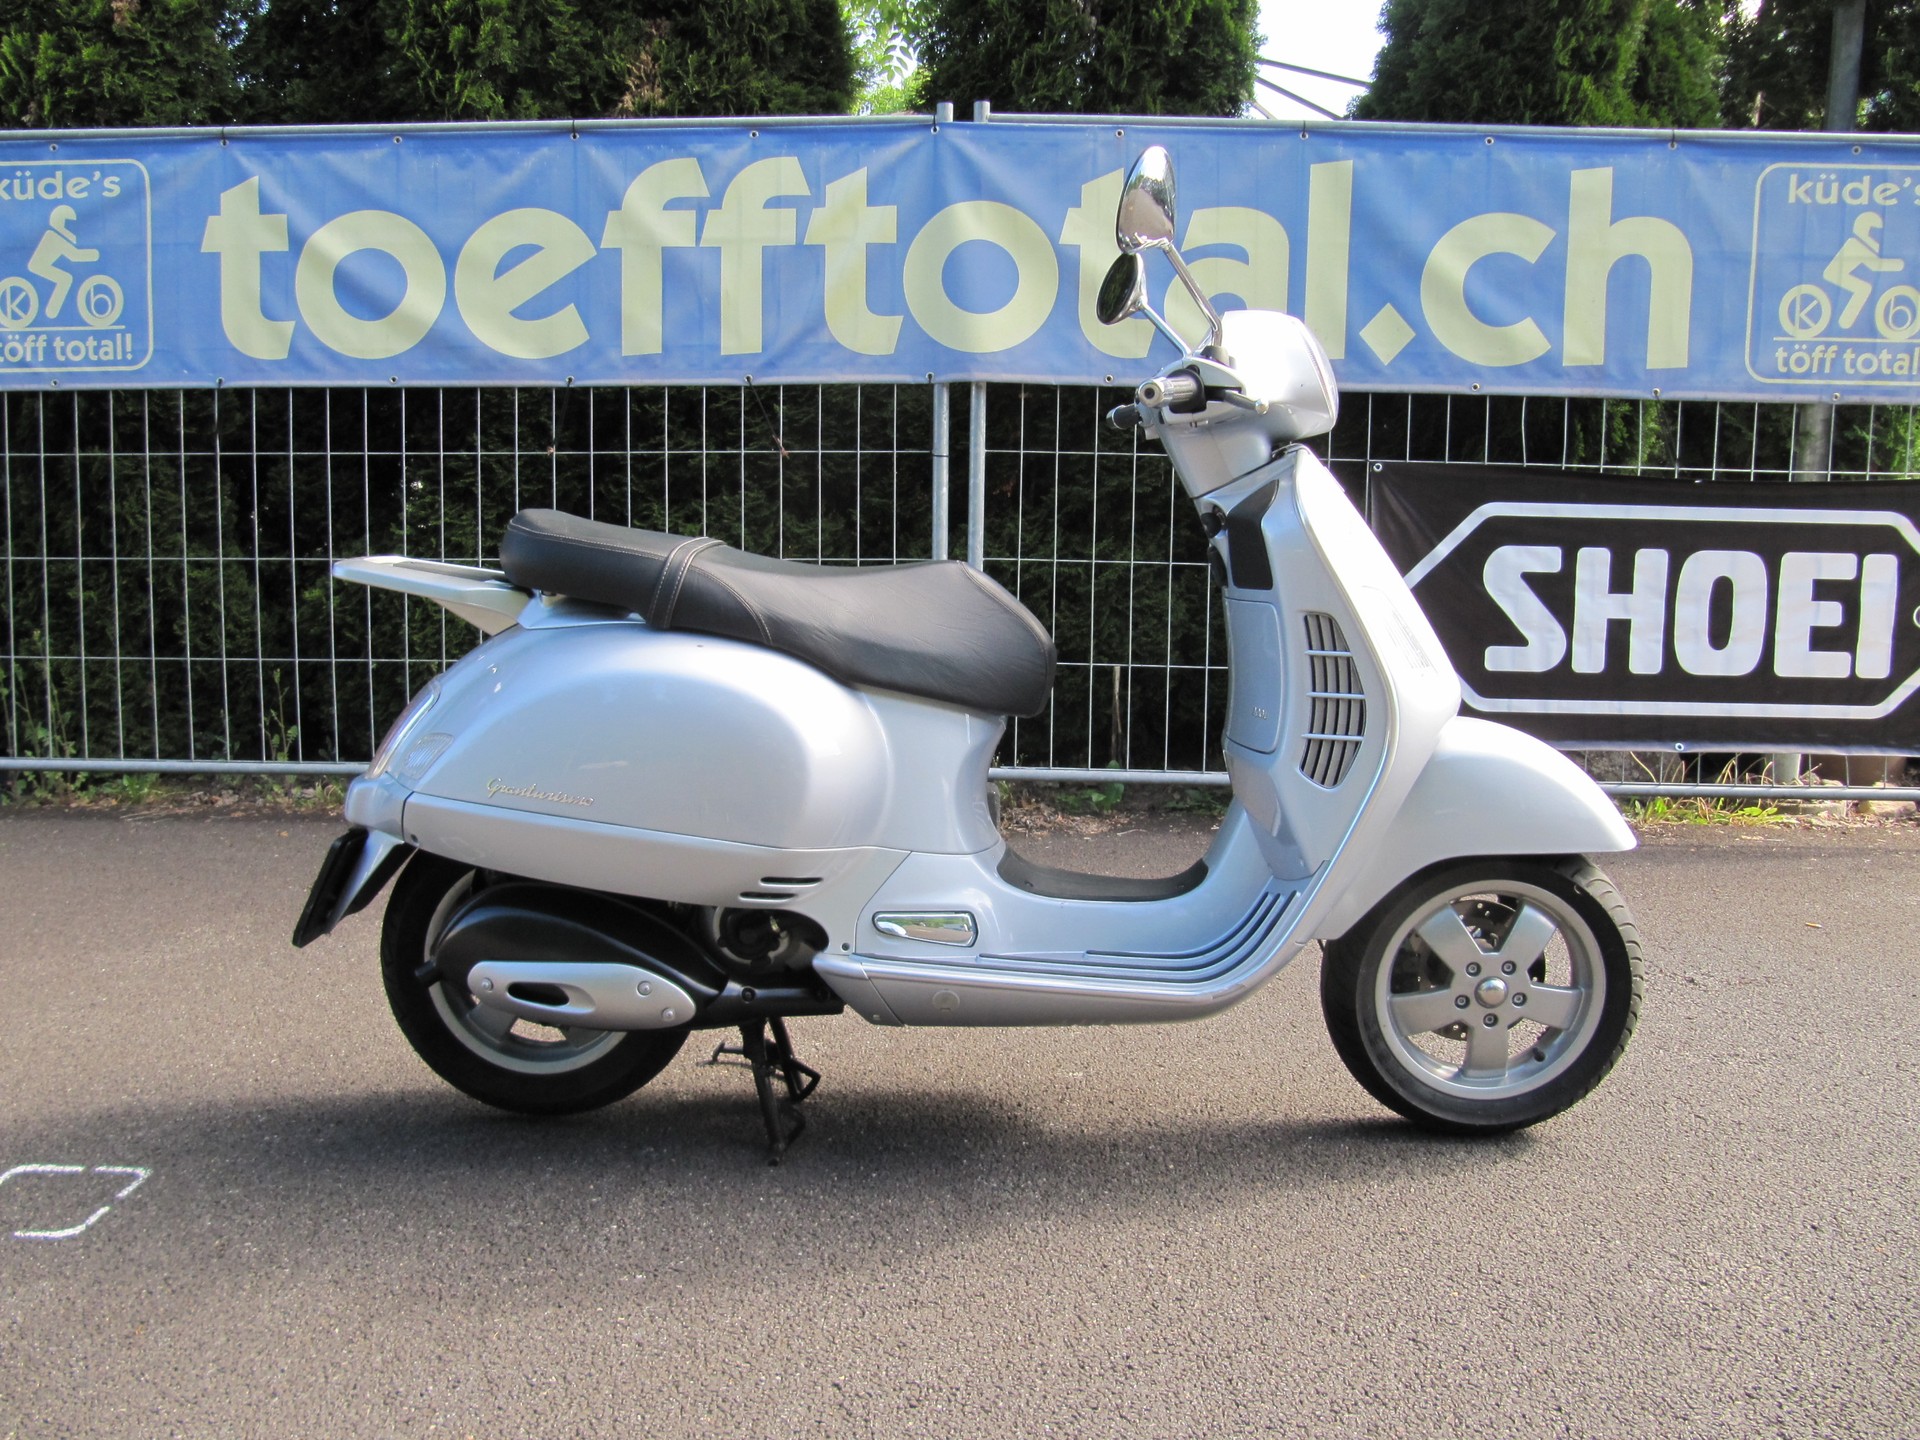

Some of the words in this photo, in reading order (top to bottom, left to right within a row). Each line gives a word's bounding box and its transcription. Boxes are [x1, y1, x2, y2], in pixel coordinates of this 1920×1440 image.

[53, 332, 133, 361] total!
[1775, 344, 1838, 374] töff
[1483, 545, 1898, 679] SHOEI
